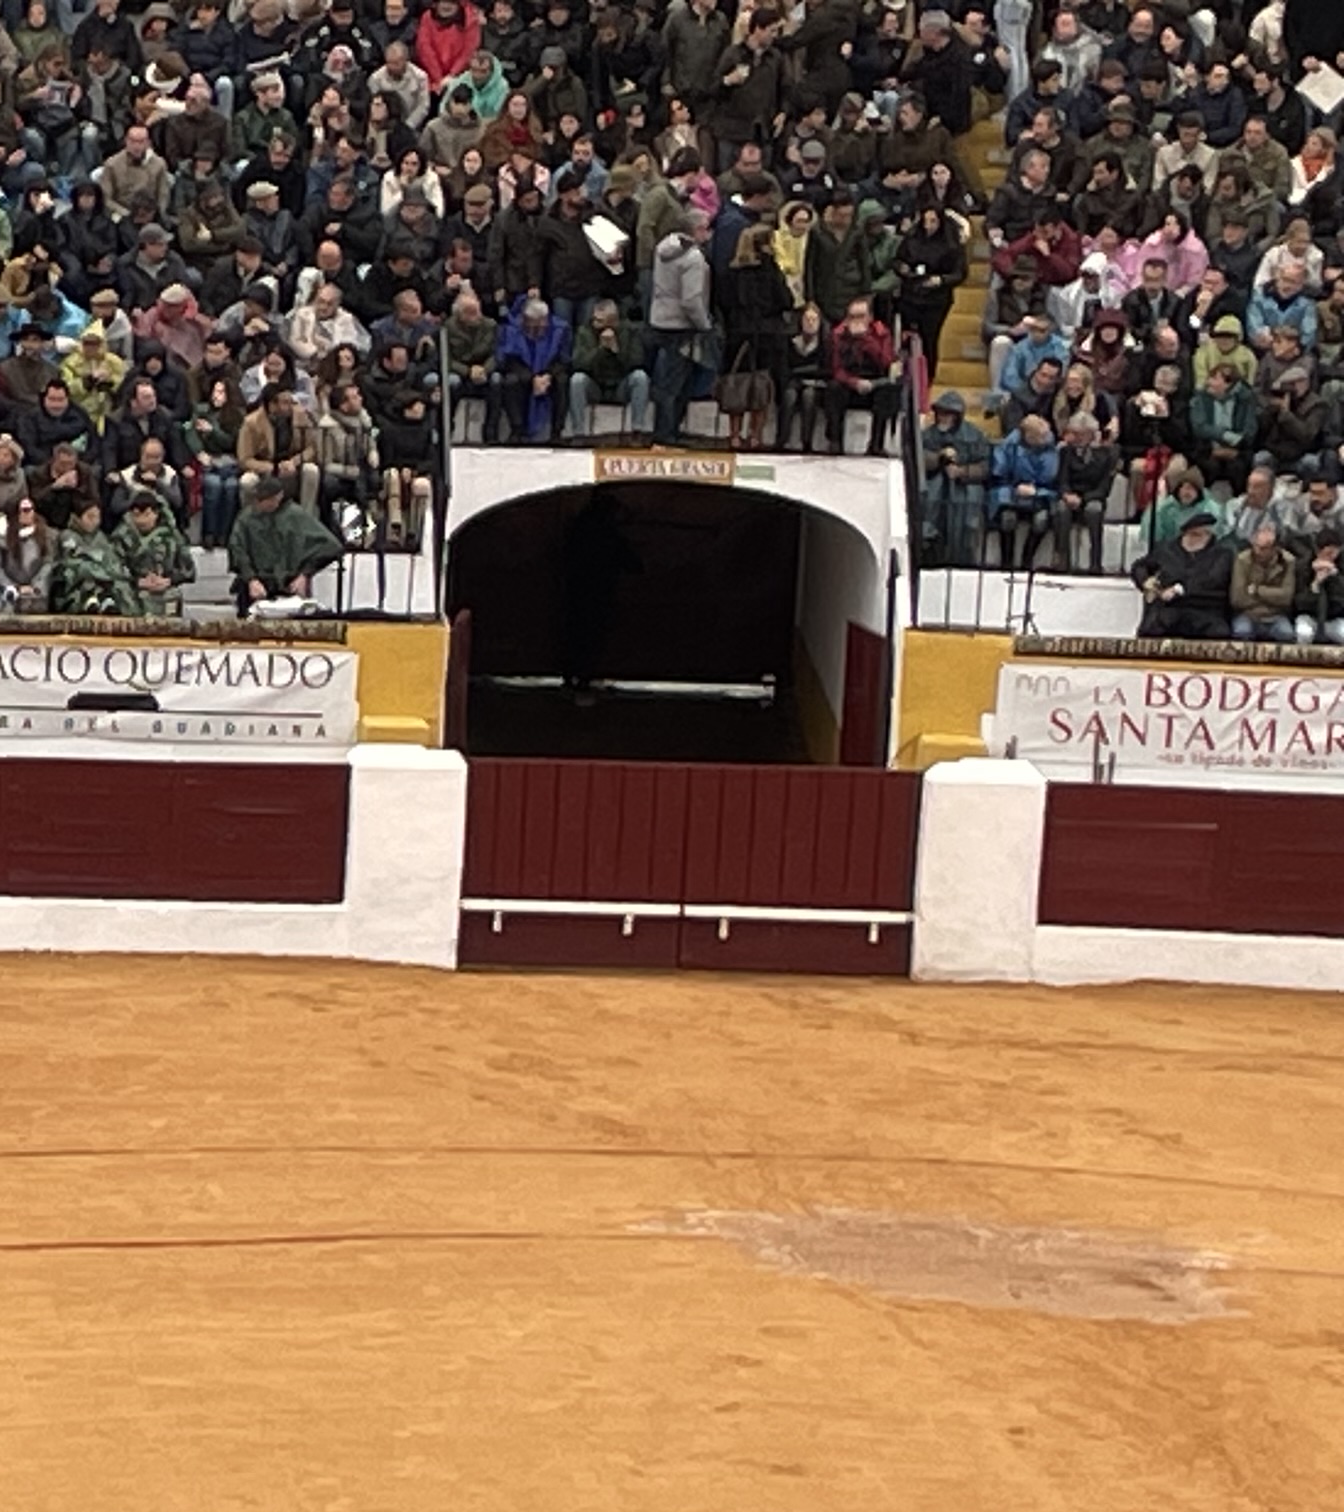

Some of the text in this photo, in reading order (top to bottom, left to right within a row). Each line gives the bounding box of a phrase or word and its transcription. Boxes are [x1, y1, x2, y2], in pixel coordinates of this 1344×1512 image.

[103, 648, 335, 691] QUEMADO
[1093, 686, 1127, 706] LA
[152, 720, 327, 737] GUADIANA
[1048, 708, 1216, 751] SANTA
